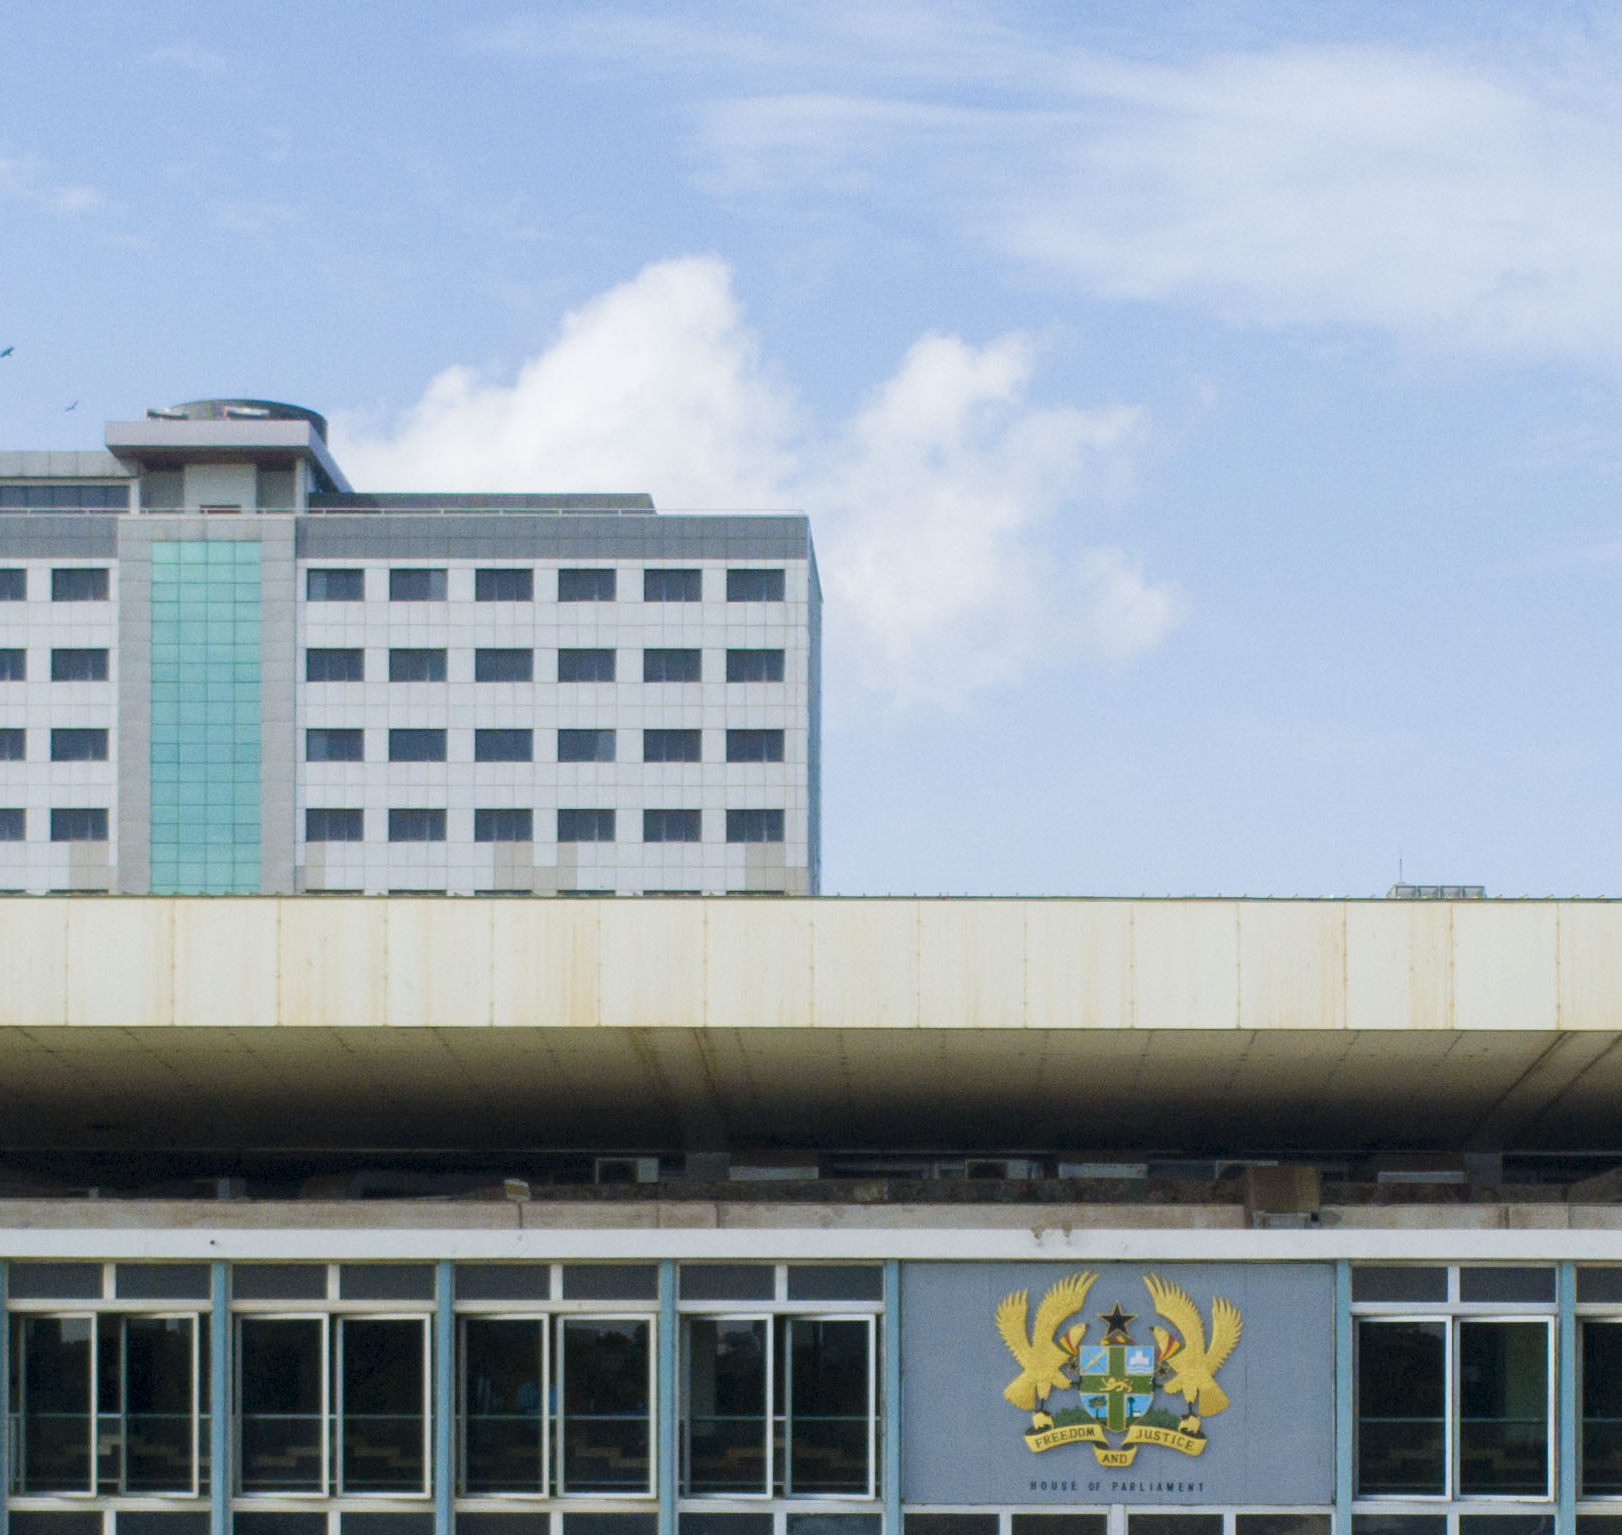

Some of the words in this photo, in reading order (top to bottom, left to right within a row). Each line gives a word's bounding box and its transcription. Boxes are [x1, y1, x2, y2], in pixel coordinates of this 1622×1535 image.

[1034, 1427, 1096, 1448] FREEDOM
[1101, 1453, 1128, 1465] AND
[1135, 1429, 1195, 1450] JUSTICE
[1030, 1481, 1077, 1491] HOUSE
[1088, 1481, 1100, 1491] OF
[1112, 1481, 1204, 1492] PARLIAMENT
